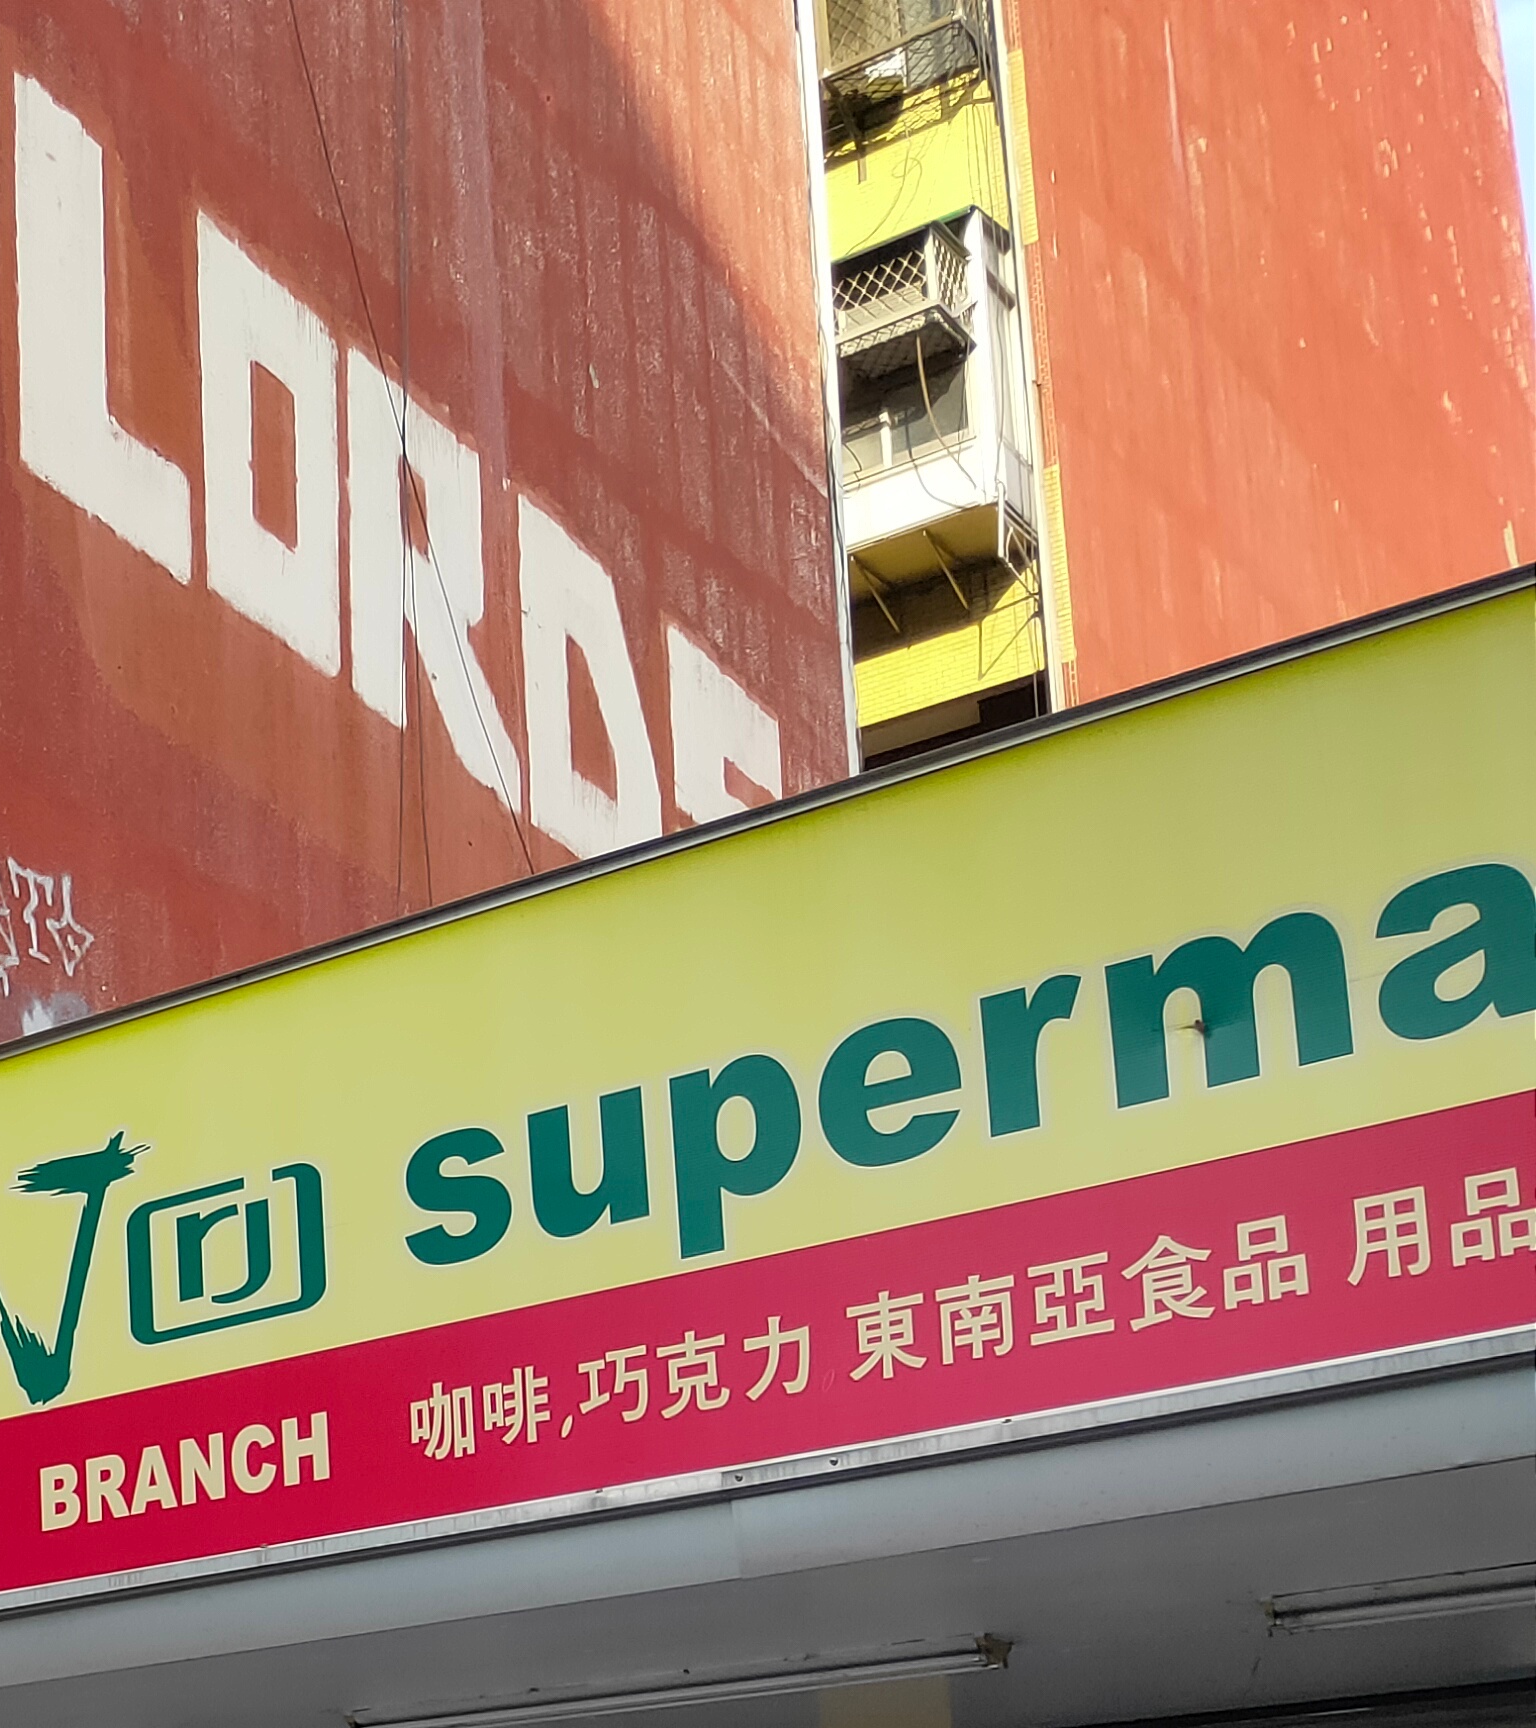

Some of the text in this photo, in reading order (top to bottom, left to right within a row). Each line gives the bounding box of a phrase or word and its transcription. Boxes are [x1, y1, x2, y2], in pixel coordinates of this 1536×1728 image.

[846, 1213, 1309, 1384] 東南亞食品
[39, 1410, 331, 1533] BRANCH
